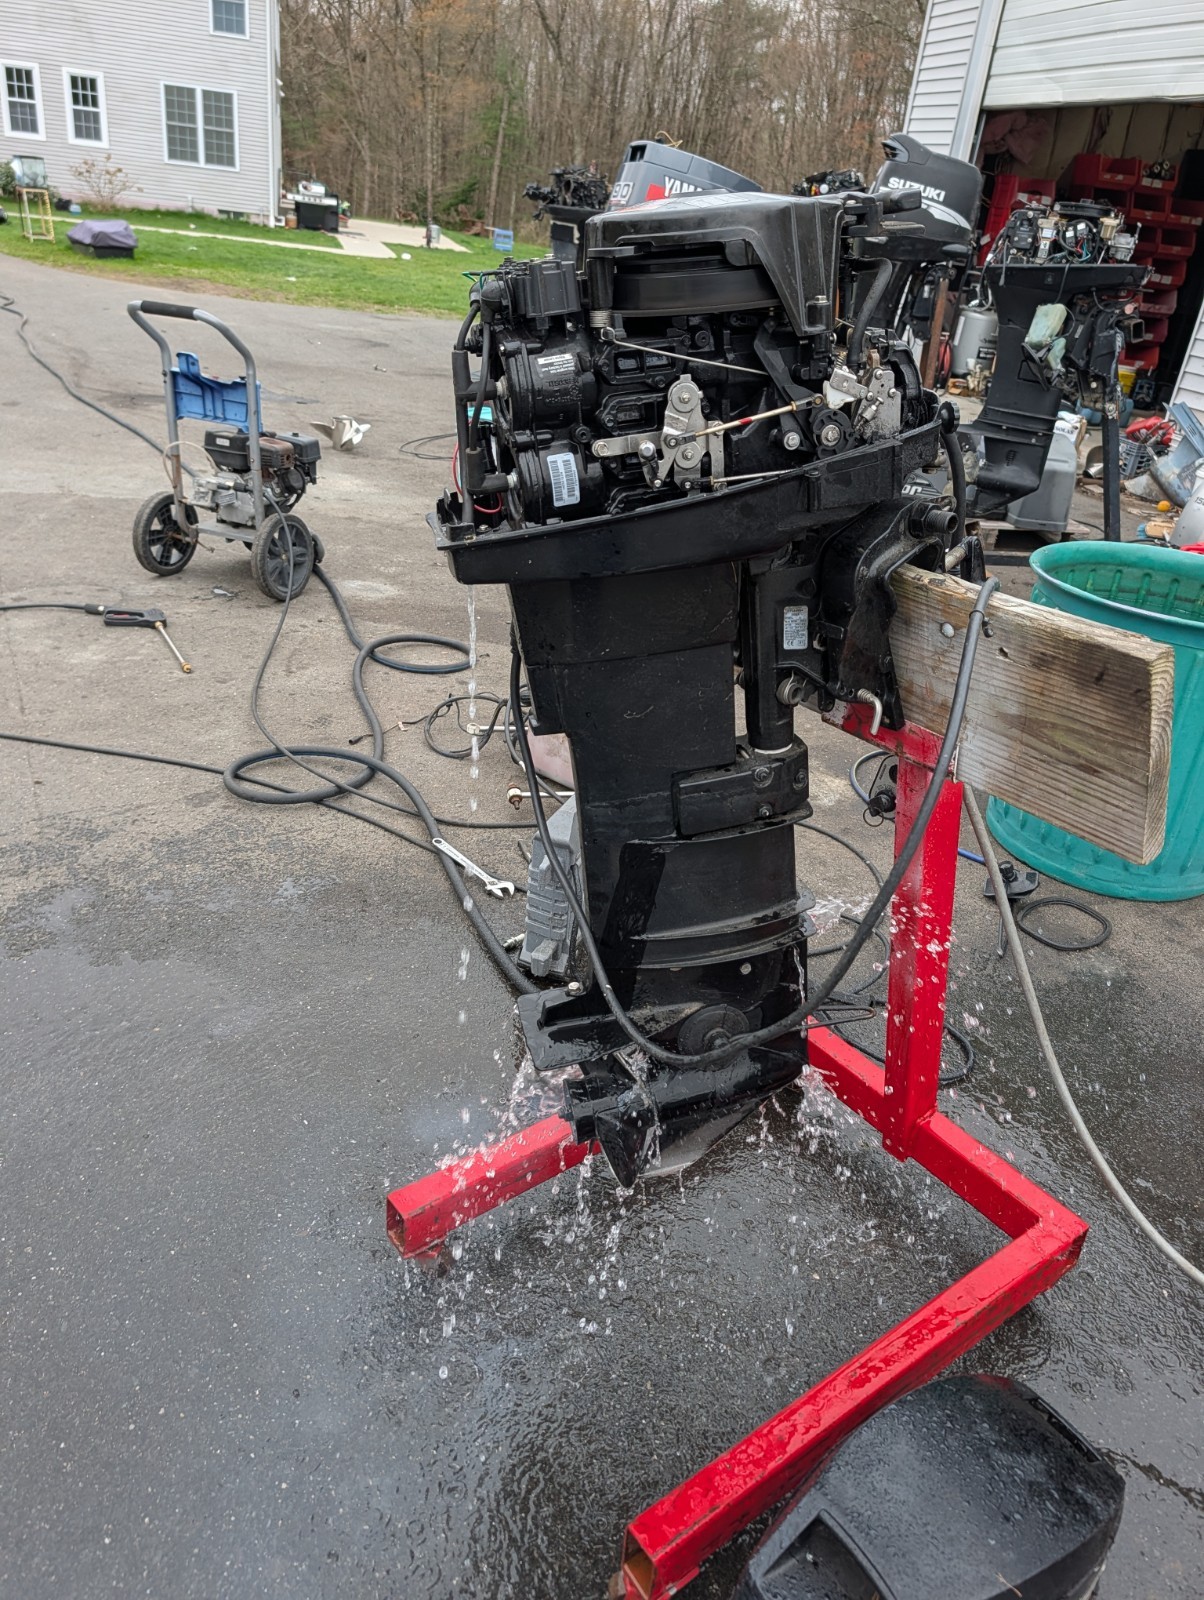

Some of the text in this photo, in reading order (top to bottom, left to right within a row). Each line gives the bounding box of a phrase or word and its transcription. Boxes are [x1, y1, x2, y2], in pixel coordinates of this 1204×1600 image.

[612, 183, 632, 199] 90
[664, 176, 703, 198] YAM
[888, 177, 946, 202] SUZUKI
